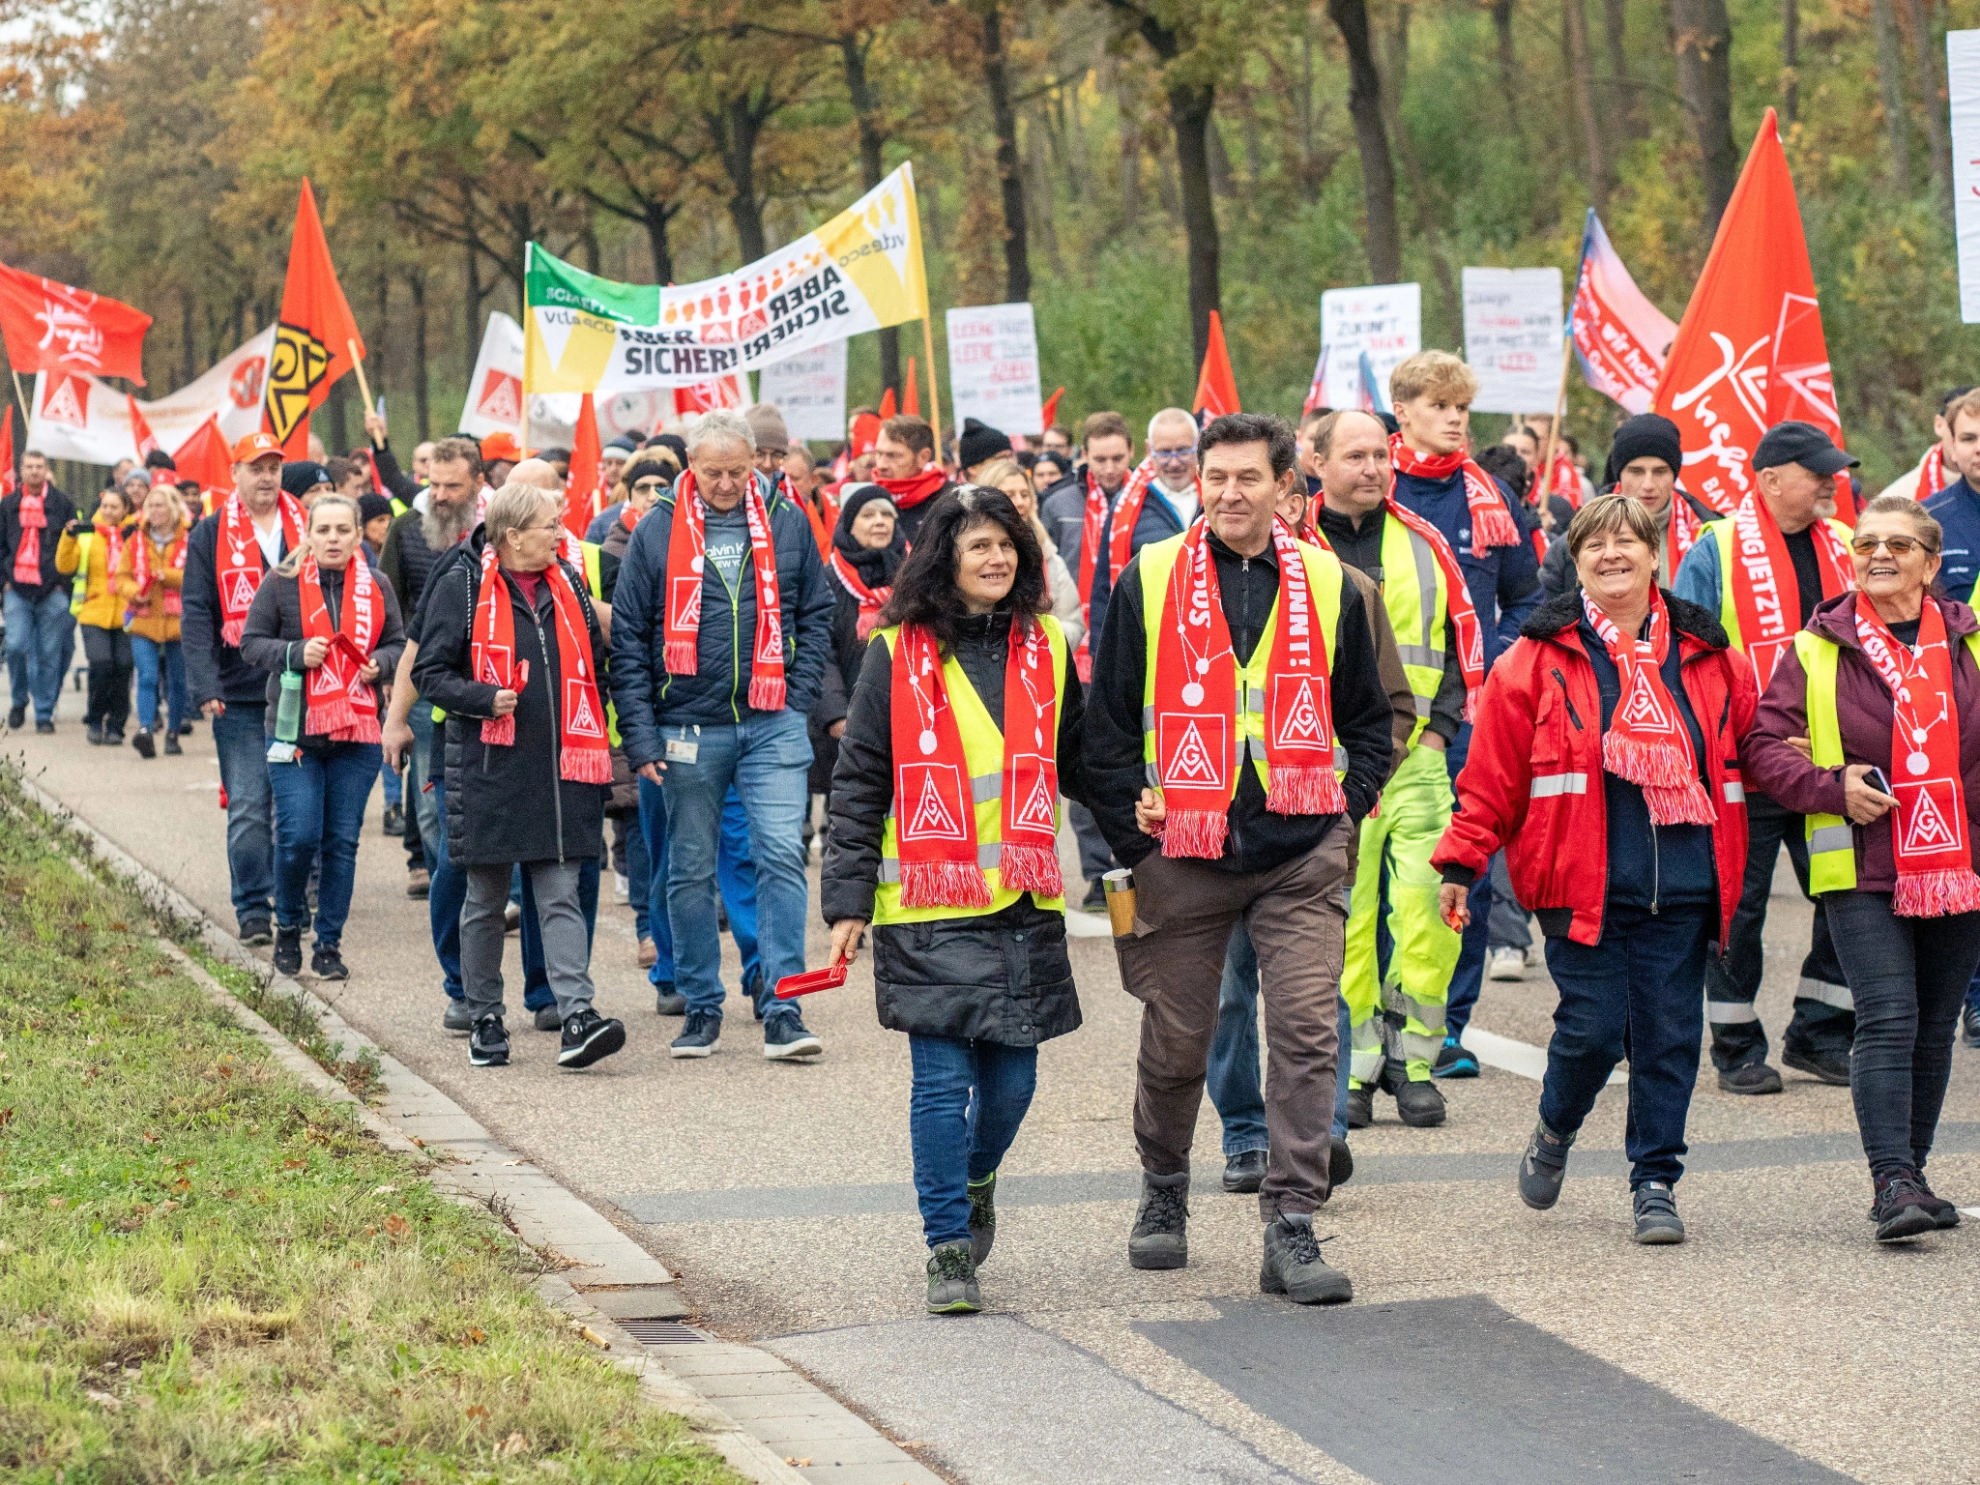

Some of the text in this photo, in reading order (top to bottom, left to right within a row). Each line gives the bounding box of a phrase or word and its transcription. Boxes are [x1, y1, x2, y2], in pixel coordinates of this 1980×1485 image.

[624, 346, 738, 376] SICHER!
[705, 543, 736, 557] alvin
[1271, 517, 1311, 668] GEWINNT!
[1741, 554, 1787, 638] JETZT!
